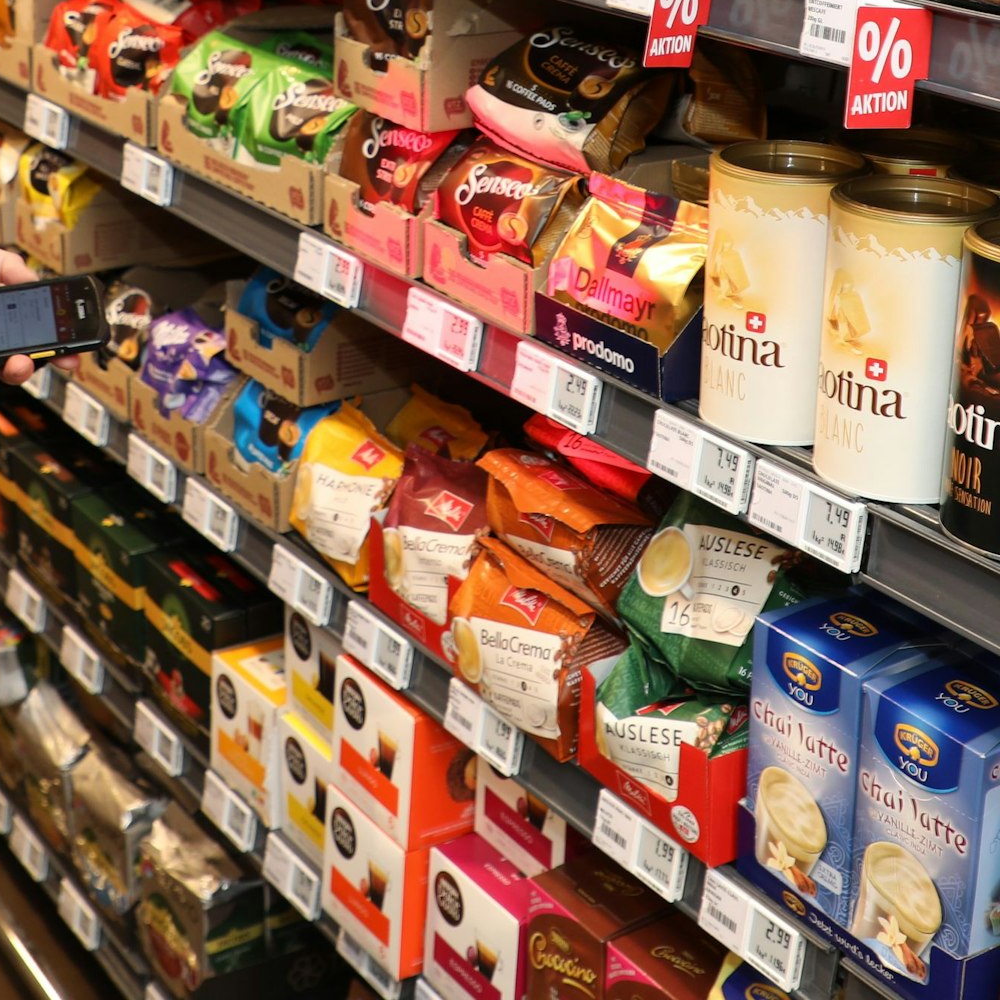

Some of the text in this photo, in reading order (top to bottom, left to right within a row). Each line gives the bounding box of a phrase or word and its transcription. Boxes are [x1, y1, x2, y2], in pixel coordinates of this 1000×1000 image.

[529, 26, 636, 69] Senseo
[649, 35, 692, 57] AKTION
[858, 16, 914, 84] %
[512, 83, 538, 102] COFFEE
[536, 95, 557, 111] PADS
[851, 90, 908, 116] AKTION
[362, 116, 433, 159] Senseo
[455, 162, 539, 206] Senseo
[574, 266, 656, 322] Dallmayr
[572, 331, 635, 374] prodomo
[717, 447, 740, 472] 7.49
[951, 446, 982, 494] NOIR
[825, 501, 851, 529] 7.49
[699, 534, 769, 561] AUSLESE
[668, 602, 691, 626] 16
[481, 630, 551, 660] BellaCrema
[819, 622, 850, 641] YOU
[508, 658, 533, 674] Crema
[788, 682, 814, 706] YOU
[935, 692, 970, 713] YOU
[605, 721, 684, 748] AUSLESE
[753, 699, 849, 773] chai latte
[900, 730, 934, 758] KRÜGER
[899, 756, 929, 783] YOU
[861, 771, 968, 854] chai latte
[877, 810, 944, 857] VANILLE-ZIMT
[655, 838, 676, 862] 1.99
[765, 919, 791, 949] 2.99
